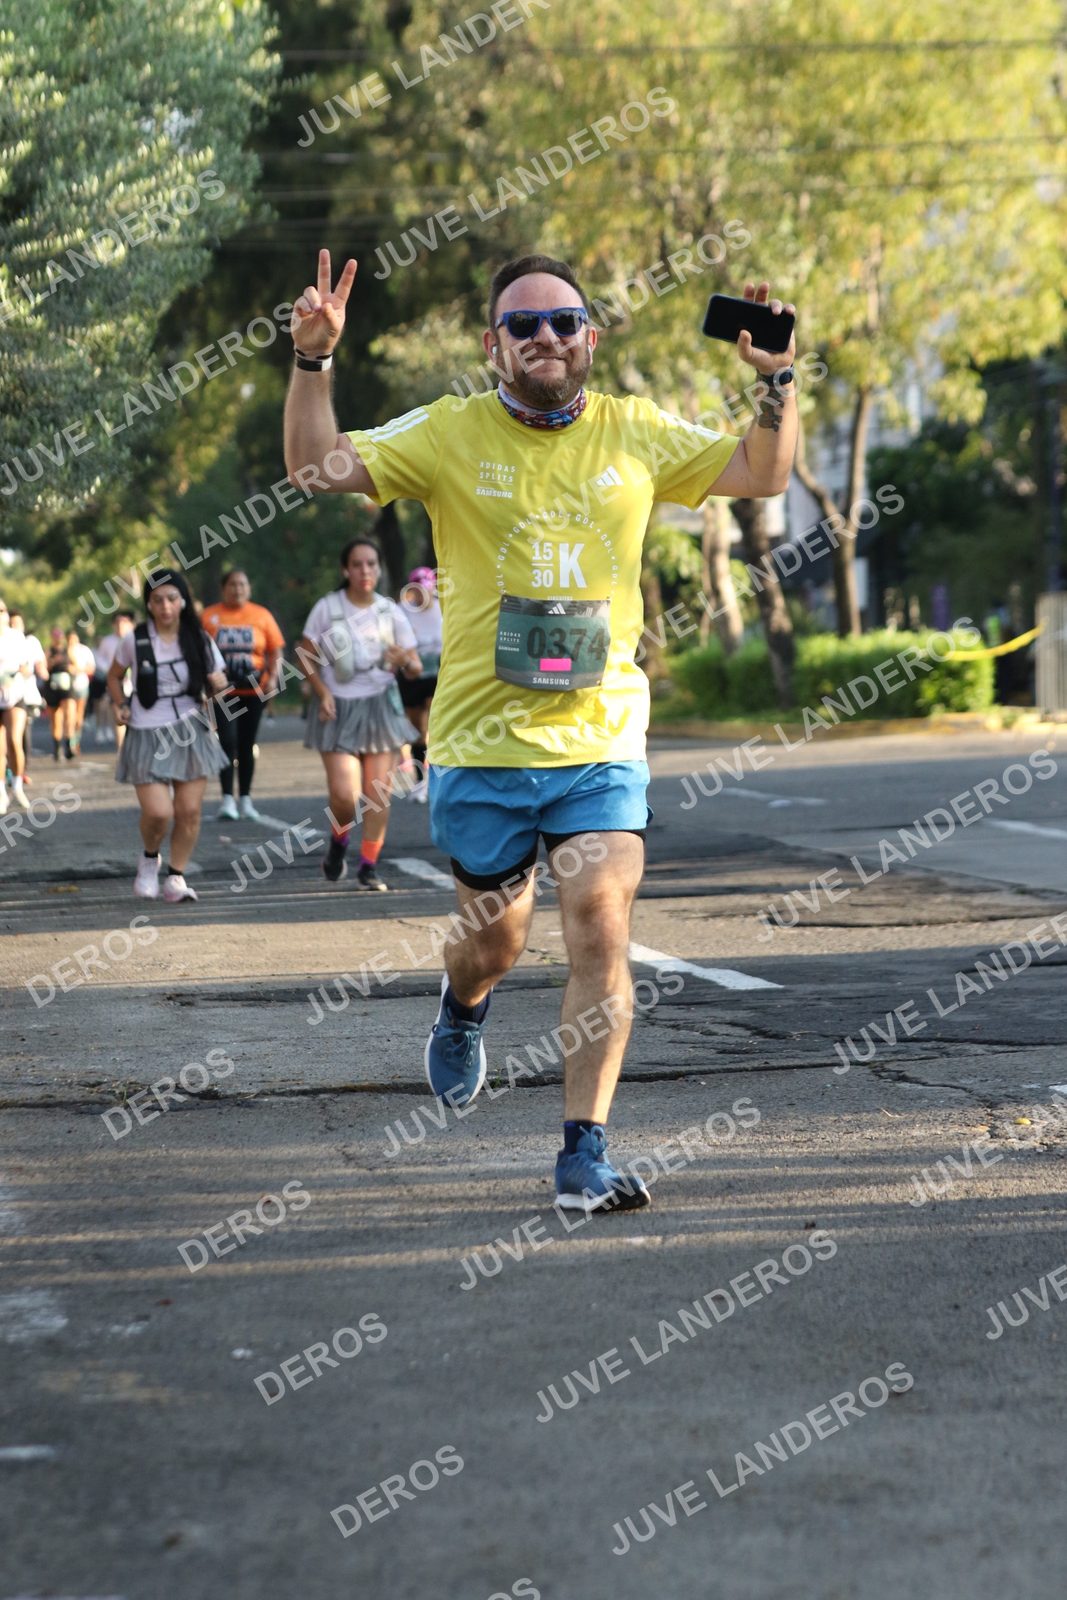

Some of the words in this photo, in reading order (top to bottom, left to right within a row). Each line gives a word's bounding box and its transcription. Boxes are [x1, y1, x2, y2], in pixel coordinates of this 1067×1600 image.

[480, 461, 516, 473] ADIDAS
[479, 471, 513, 483] SPLITS
[476, 488, 512, 499] SAMSUNG
[531, 542, 554, 561] 15
[559, 543, 587, 588] K
[531, 569, 554, 588] 30
[527, 626, 607, 661] 0374
[532, 677, 570, 686] SAMSUNG
